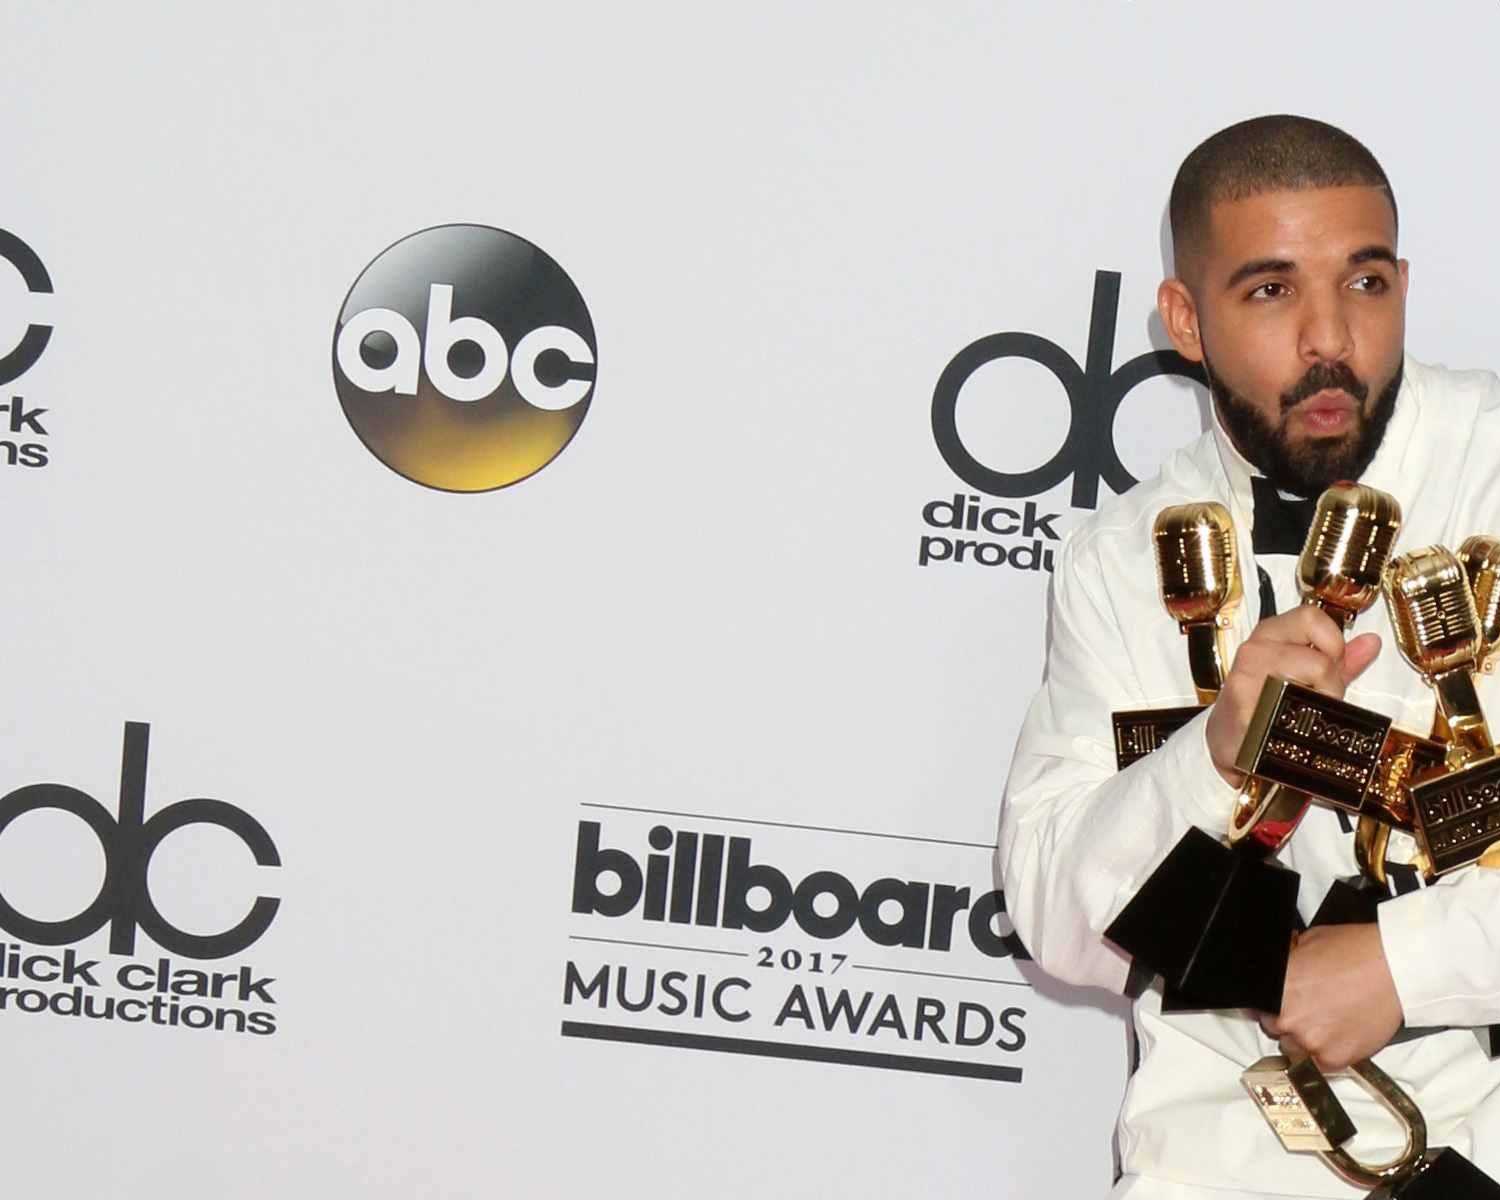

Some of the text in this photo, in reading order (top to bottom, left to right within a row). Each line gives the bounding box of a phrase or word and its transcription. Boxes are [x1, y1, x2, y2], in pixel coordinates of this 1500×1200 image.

[337, 283, 594, 410] abc
[922, 494, 1062, 541] dick
[1117, 725, 1168, 755] billb
[0, 943, 275, 1003] ick clark
[758, 947, 847, 973] 2017
[0, 986, 275, 1035] roductions
[564, 961, 1026, 1051] MUSIC AWARDS
